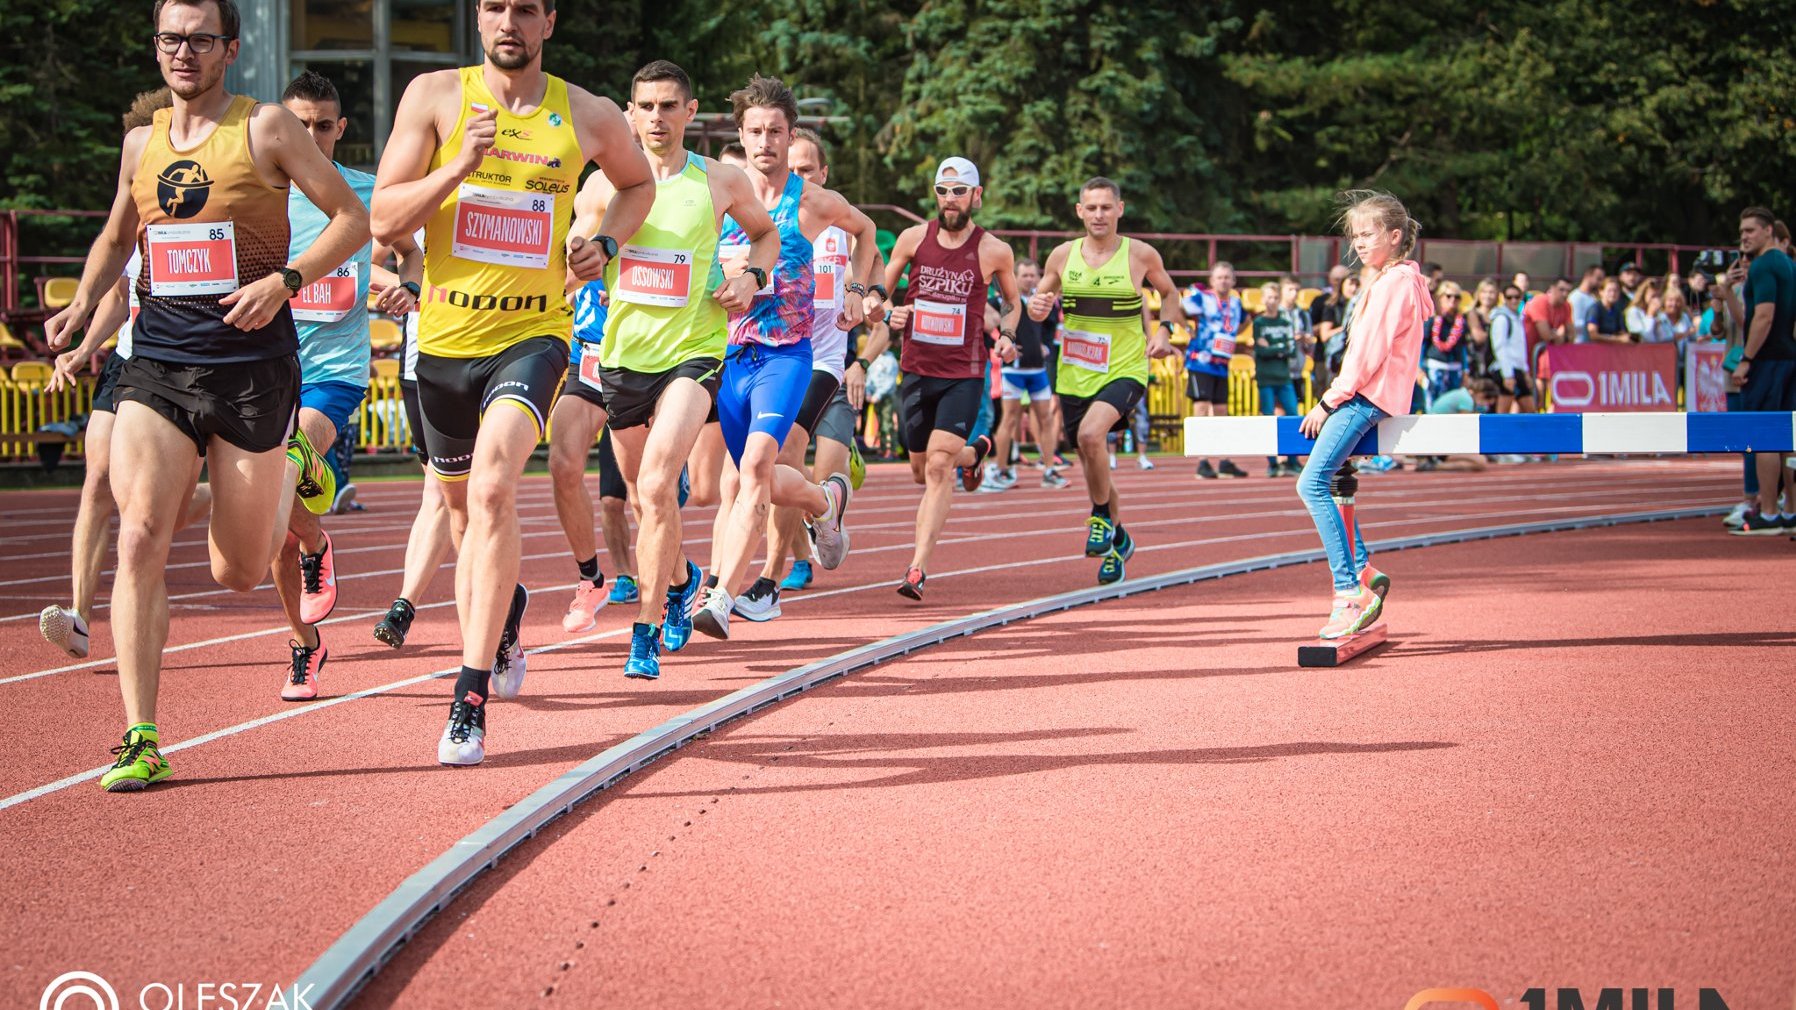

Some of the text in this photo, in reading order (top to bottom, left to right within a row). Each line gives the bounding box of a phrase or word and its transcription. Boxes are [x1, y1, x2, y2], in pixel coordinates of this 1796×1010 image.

[532, 199, 545, 212] 88
[209, 228, 225, 240] 85
[465, 211, 543, 245] SZYMANOWSKI
[167, 248, 212, 274] TOMCZYK
[674, 254, 686, 264] 79
[337, 267, 350, 277] 86
[631, 265, 675, 289] OSSOWSKI
[819, 265, 832, 273] 101
[920, 265, 965, 282] DRUŻYNA
[302, 283, 331, 304] EL BAH
[918, 275, 973, 295] SZPIKU
[952, 307, 961, 315] 74
[1598, 371, 1672, 405] 1MILA
